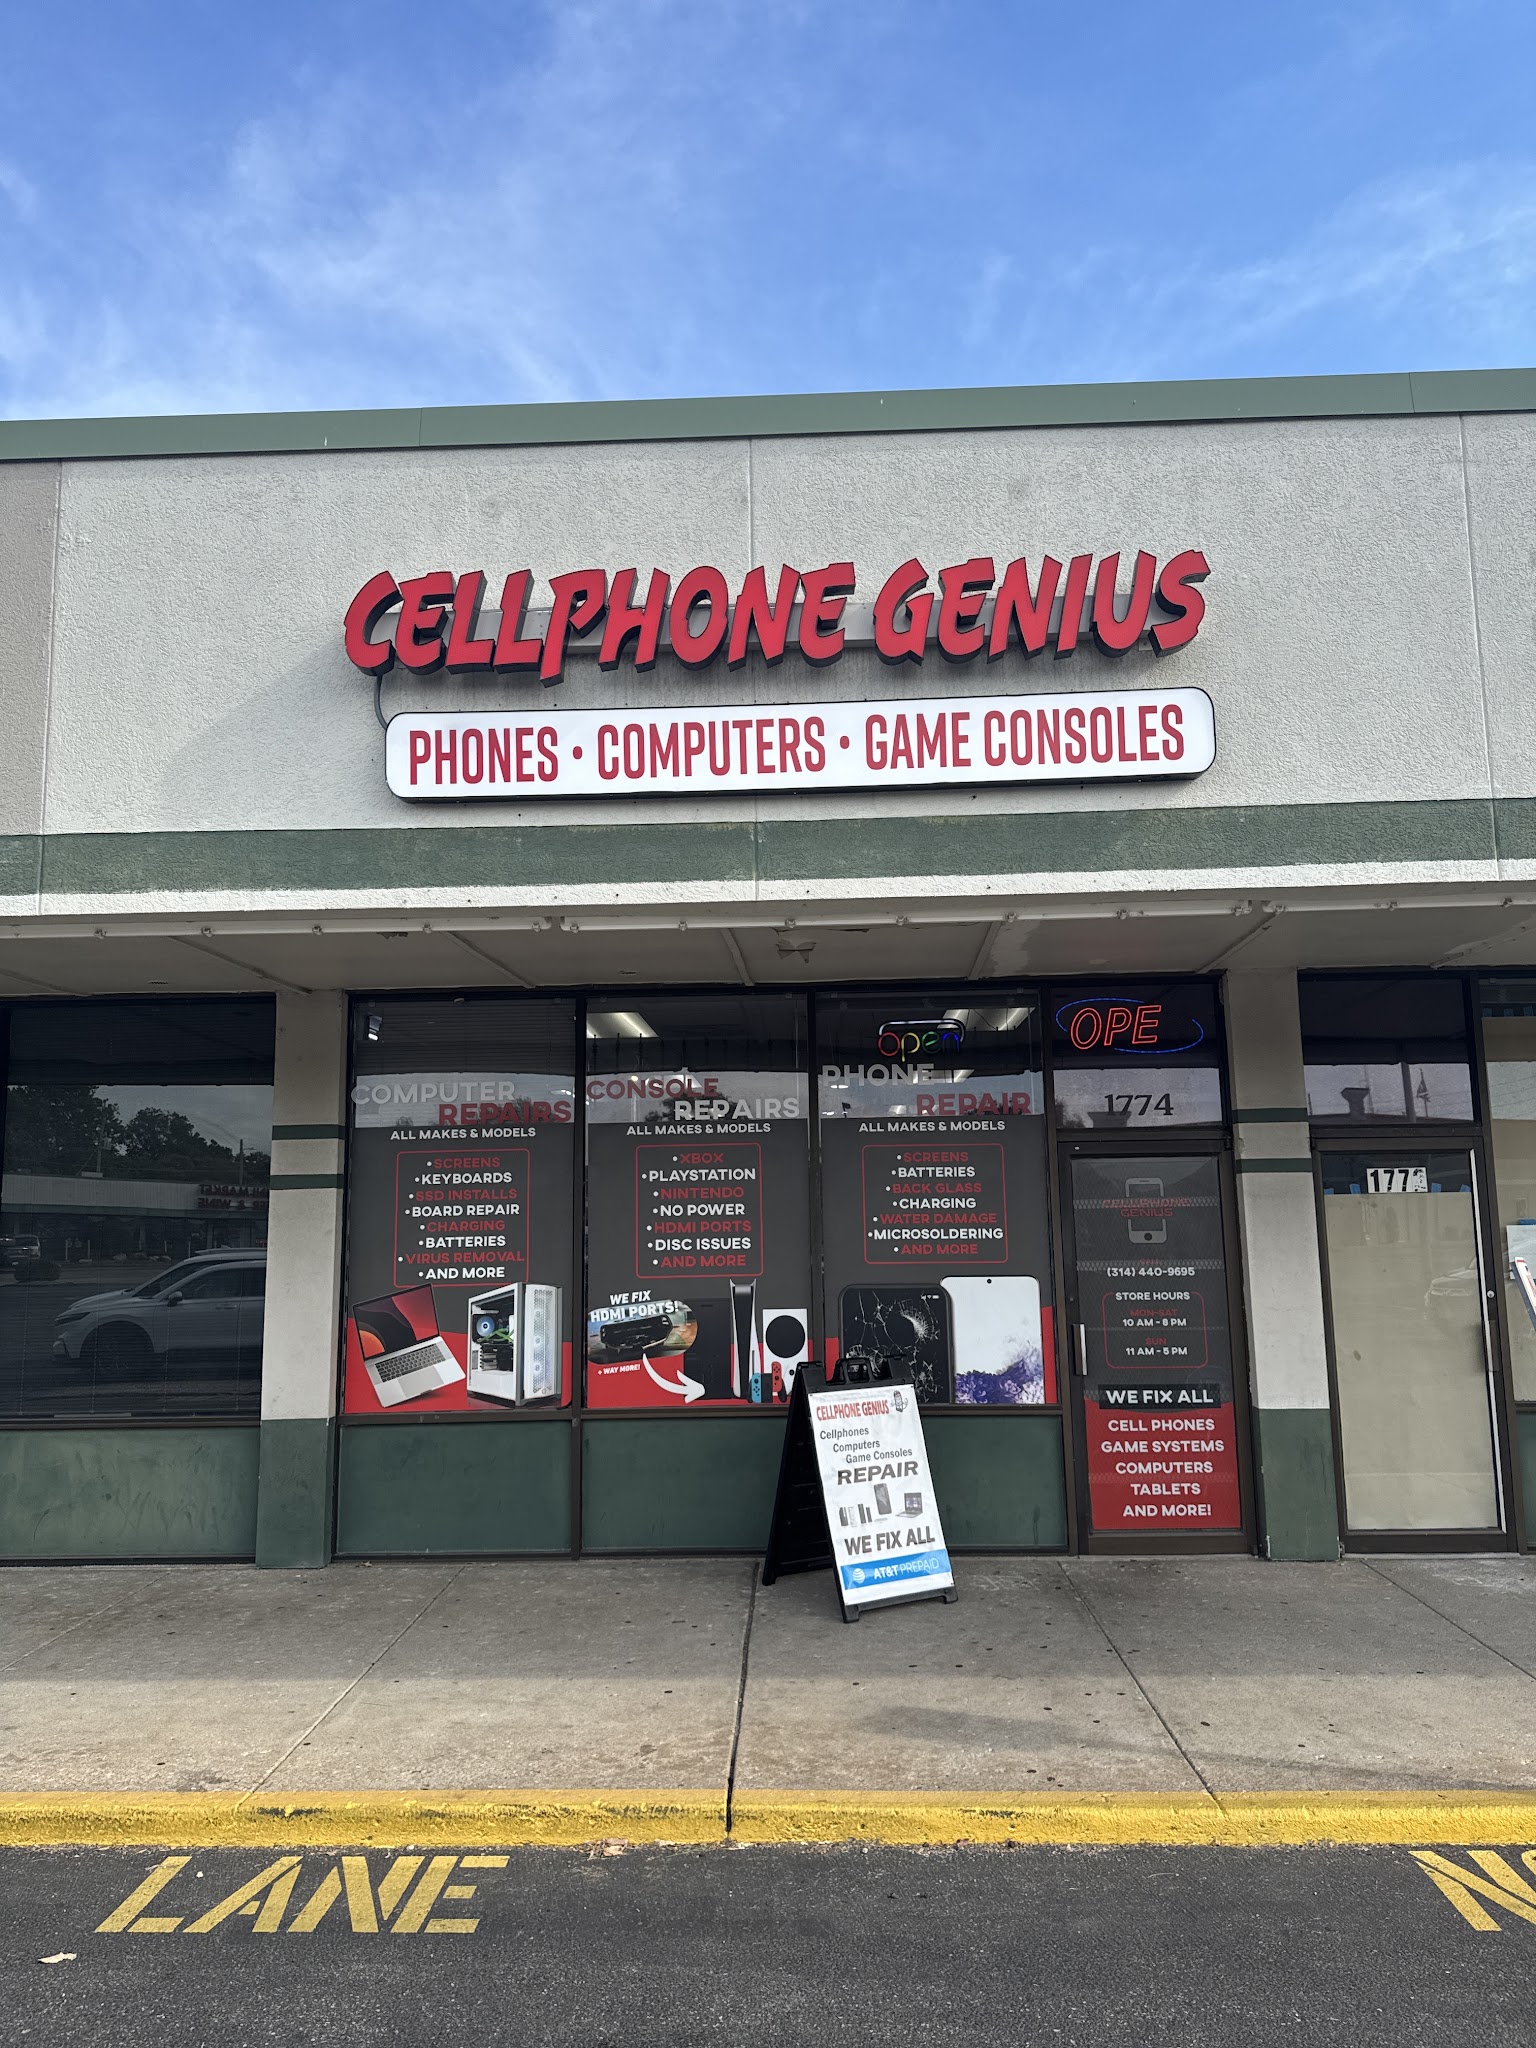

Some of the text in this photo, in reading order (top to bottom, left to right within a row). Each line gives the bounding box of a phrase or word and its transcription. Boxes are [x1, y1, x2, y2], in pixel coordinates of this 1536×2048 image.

[344, 550, 1211, 687] CELLPHONE GENIUS
[409, 704, 1185, 786] PHONES COMPUTERS GAME CONSOLES
[1070, 1004, 1162, 1050] OPE
[877, 1031, 961, 1062] open
[821, 1063, 935, 1087] PHONE
[351, 1080, 516, 1105] COMPUTER
[586, 1078, 719, 1100] CONSOLE
[674, 1097, 800, 1121] REPAIRS
[916, 1092, 1031, 1116] REPAIR
[1104, 1093, 1174, 1116] 1774
[438, 1100, 572, 1126] REPAIRS
[626, 1122, 771, 1136] ALL MAKES & MODELS
[859, 1120, 1006, 1133] ALL MAKES & MODELS
[390, 1127, 536, 1141] ALL MAKES & MODELS
[434, 1157, 500, 1169] SCREENS
[680, 1153, 724, 1164] XBOX
[903, 1152, 968, 1162] SCREENS
[421, 1172, 512, 1185] KEYBOARDS
[649, 1168, 756, 1182] PLAYSTATION
[898, 1167, 975, 1177] BATTERIES
[416, 1188, 518, 1201] SSD INSTALLS
[661, 1186, 744, 1200] NINTENDO
[893, 1182, 982, 1194] BACK GLASS
[899, 1198, 976, 1209] CHARGING
[412, 1204, 520, 1218] BOARD REPAIR
[660, 1204, 745, 1217] NO POWER
[1120, 1208, 1174, 1217] GENIUS
[880, 1213, 997, 1224] WATER DAMAGE
[427, 1220, 505, 1232] CHARGING
[655, 1220, 752, 1234] HDMI PORTS
[874, 1228, 1004, 1240] MICROSOLDERING
[426, 1236, 506, 1249] BATTERIES
[655, 1237, 751, 1251] DISC ISSUES
[901, 1244, 978, 1255] AND MORE
[406, 1251, 525, 1264] VIRUS REMOVAL
[661, 1255, 746, 1268] AND MORE
[426, 1267, 505, 1279] AND MORE
[1107, 1266, 1196, 1278] (314) 440-9695
[610, 1290, 651, 1305] WE FIX
[1115, 1291, 1191, 1301] STORE HOURS
[590, 1300, 679, 1323] HDMI PORTS!
[1130, 1308, 1179, 1317] MON-SAT
[1122, 1318, 1134, 1327] 10
[1136, 1318, 1153, 1327] AM
[1162, 1318, 1169, 1326] 8
[1170, 1317, 1187, 1326] PM
[1145, 1337, 1167, 1345] SUN
[1125, 1347, 1135, 1356] 11
[1137, 1347, 1154, 1356] AM
[1163, 1347, 1170, 1355] 5
[1171, 1347, 1188, 1355] PM
[603, 1366, 619, 1375] WAY
[619, 1364, 641, 1373] MORE!
[1106, 1389, 1213, 1404] WE FIX ALL
[816, 1399, 890, 1421] CELLPHONE GENIUS
[1108, 1419, 1215, 1432] CELL PHONES
[820, 1427, 869, 1440] Cellphones
[833, 1440, 880, 1453] Computers
[1101, 1440, 1224, 1453] GAME SYSTEMS
[846, 1448, 912, 1464] Game Consoles
[837, 1460, 919, 1485] REPAIR
[1115, 1461, 1213, 1474] COMPUTERS
[1130, 1483, 1201, 1496] TABLETS
[1123, 1504, 1211, 1517] AND MORE!
[845, 1526, 935, 1556] WE FIX ALL
[874, 1558, 939, 1579] AT&T PREPAID
[95, 1855, 510, 1934] LANE
